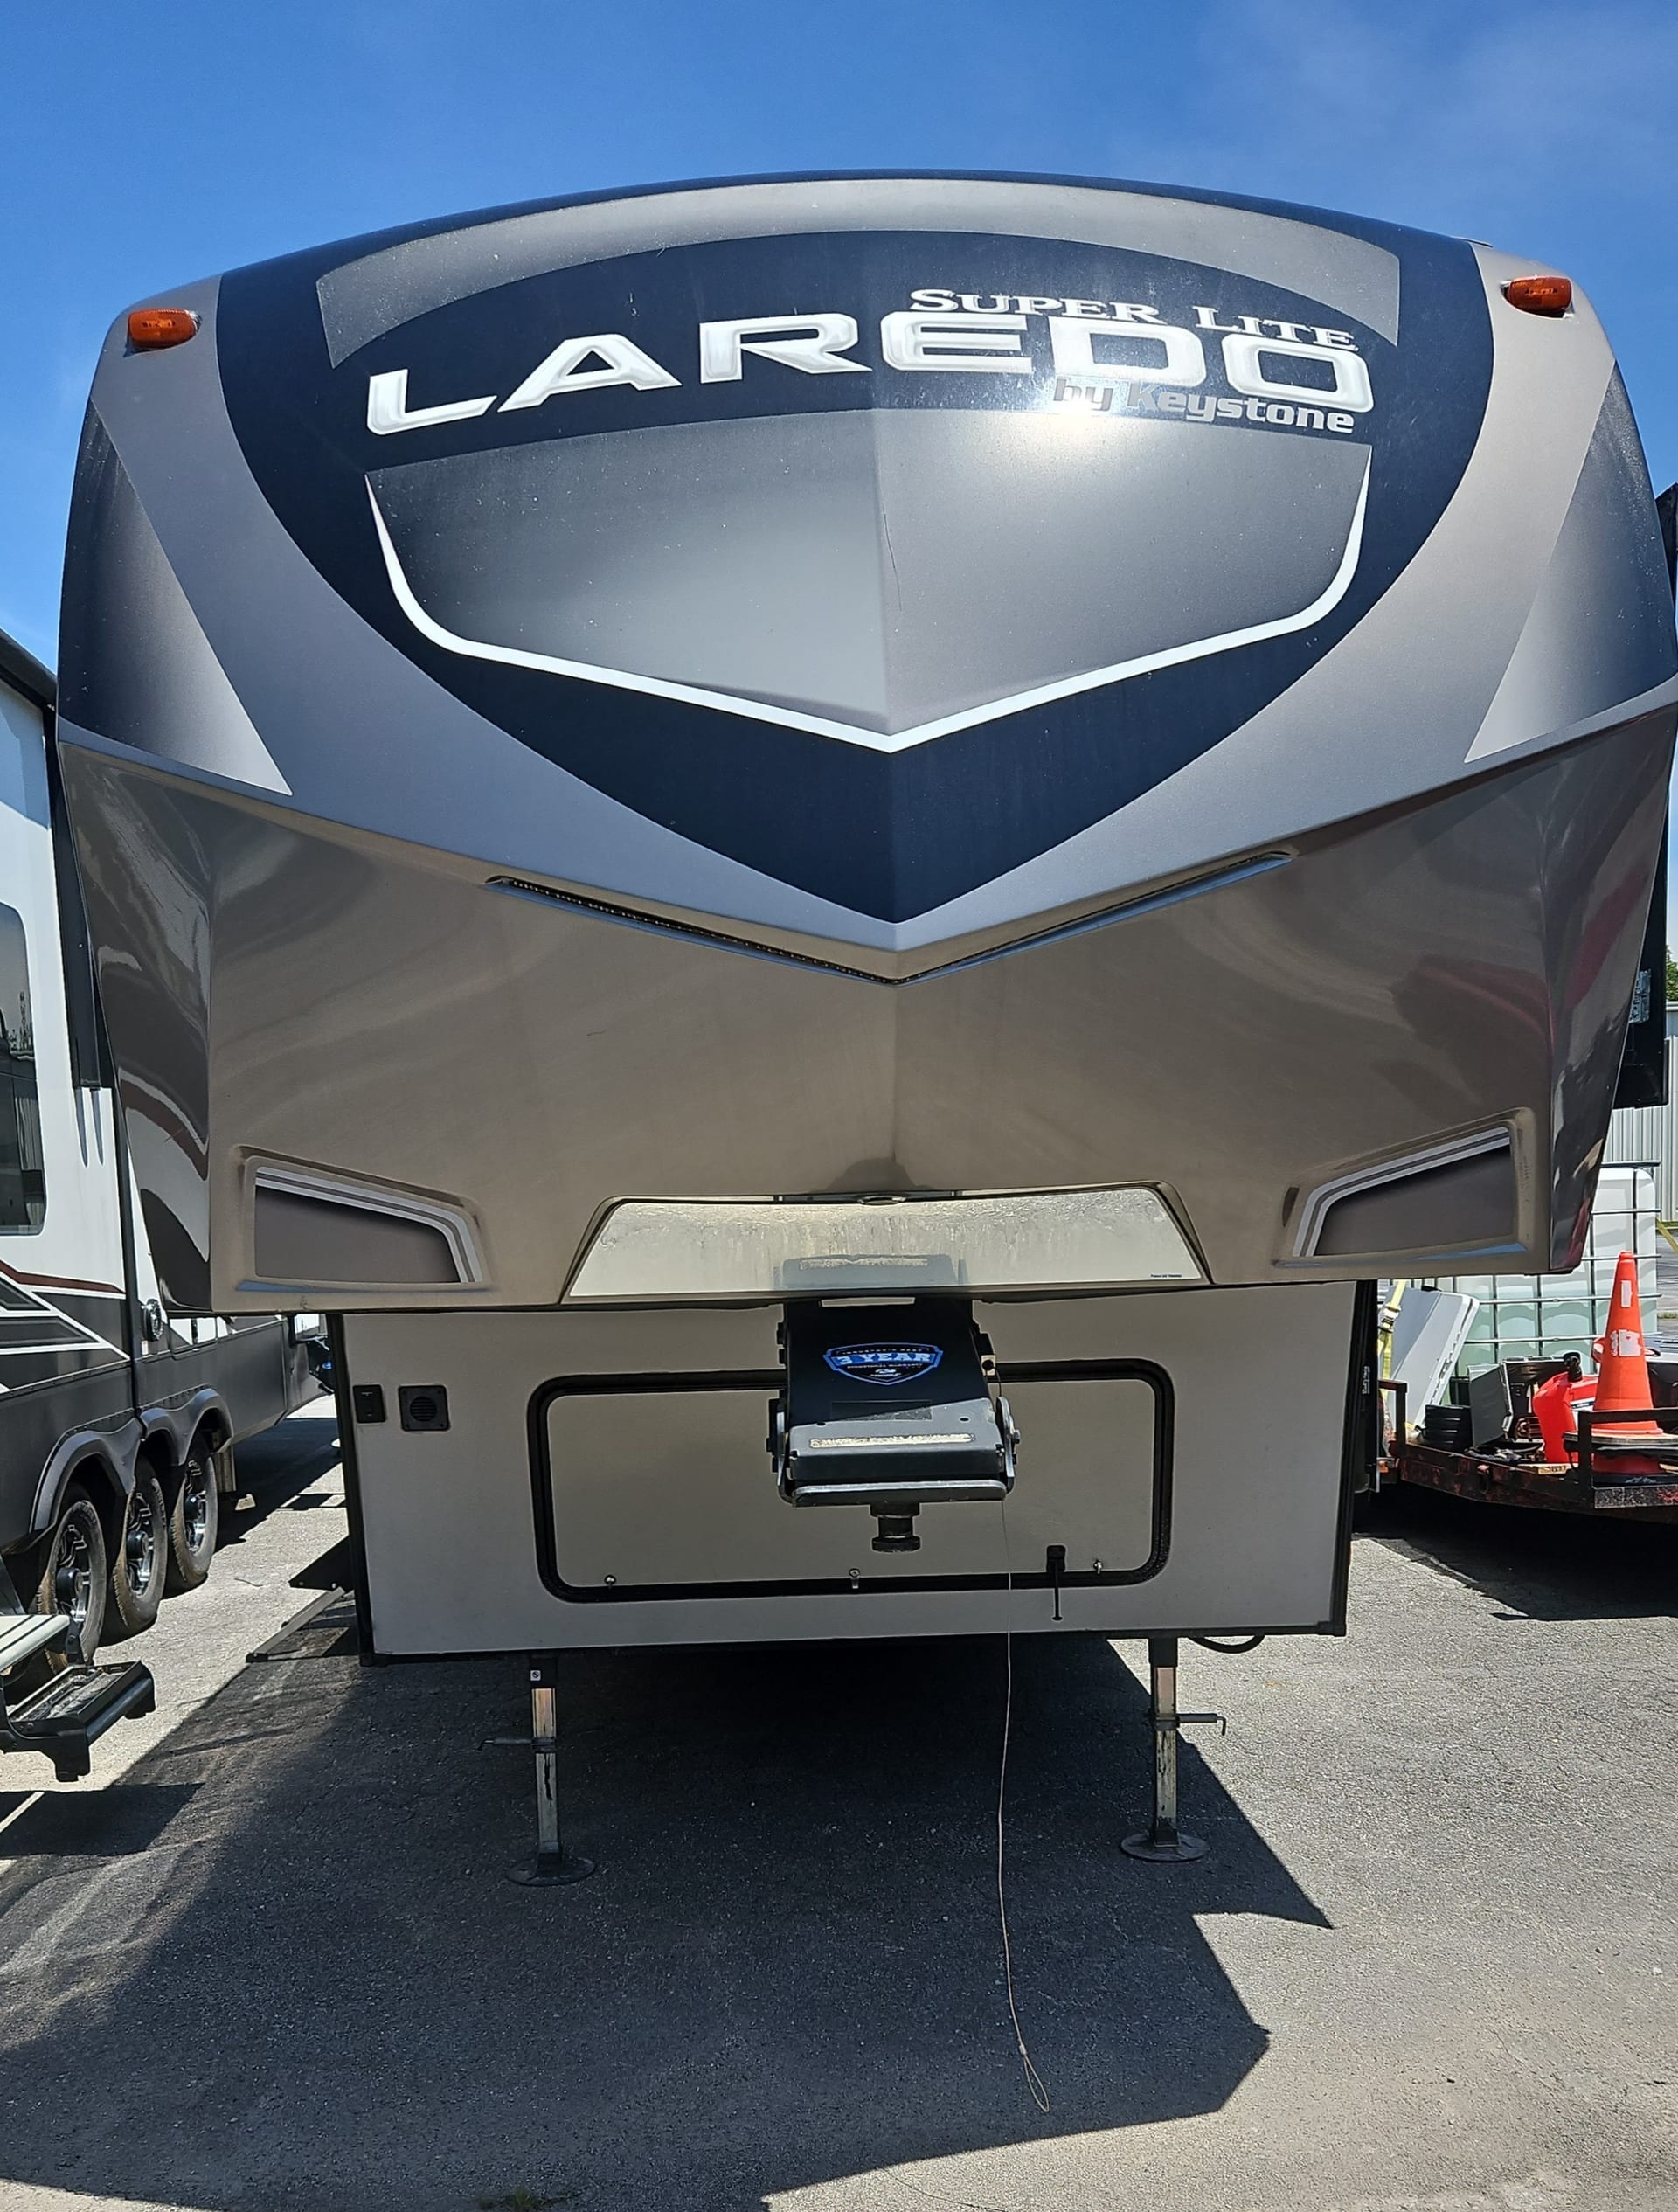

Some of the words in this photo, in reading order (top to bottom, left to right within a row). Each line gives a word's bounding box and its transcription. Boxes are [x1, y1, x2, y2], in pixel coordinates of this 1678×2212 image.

[910, 288, 1168, 324] SUPER
[1191, 305, 1360, 351] LITE
[366, 311, 1375, 435] LAREDO
[1053, 378, 1113, 412] by
[1127, 384, 1355, 434] Keystone
[858, 1352, 932, 1362] YEAR
